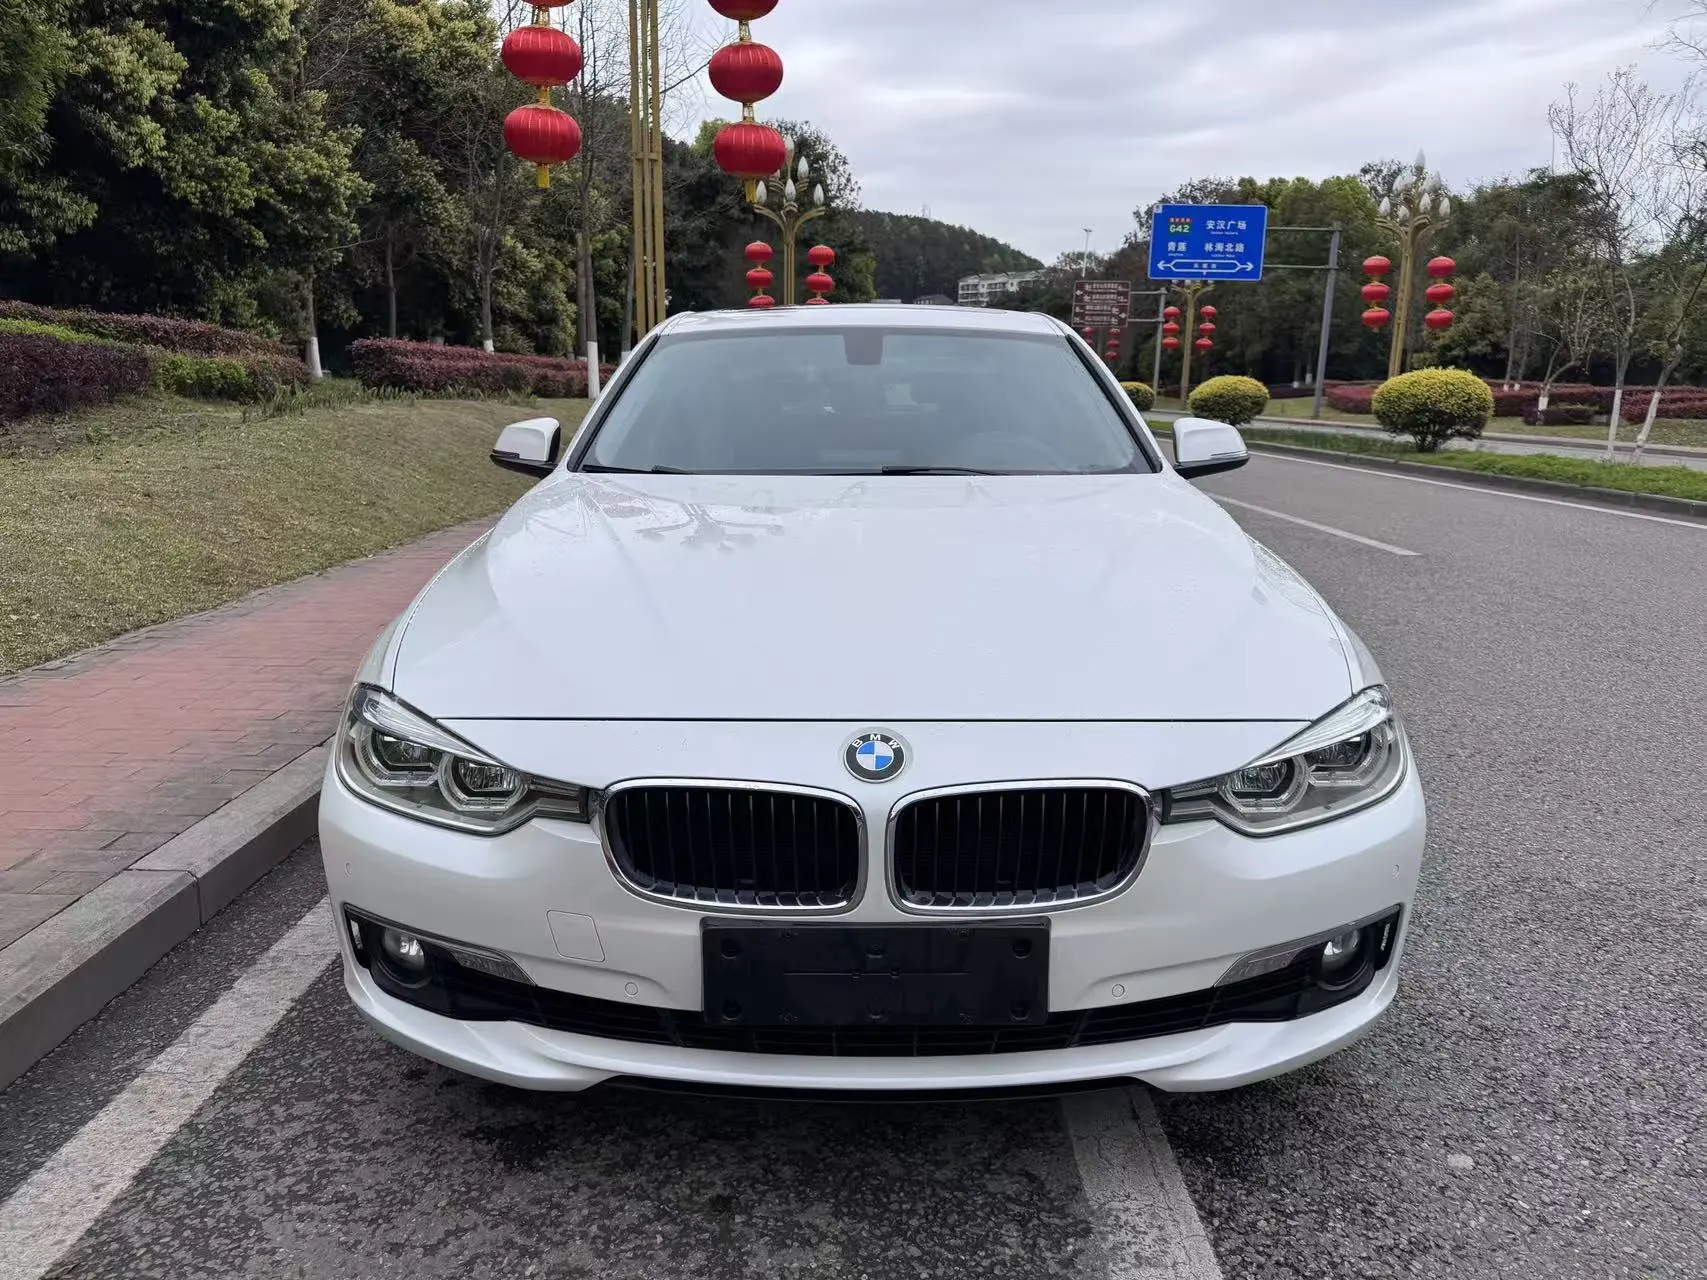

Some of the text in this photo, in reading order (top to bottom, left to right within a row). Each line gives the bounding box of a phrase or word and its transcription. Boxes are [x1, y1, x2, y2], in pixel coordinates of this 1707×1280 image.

[1169, 224, 1190, 233] G42
[1206, 220, 1247, 230] 安汉广场
[852, 734, 900, 749] BMW
